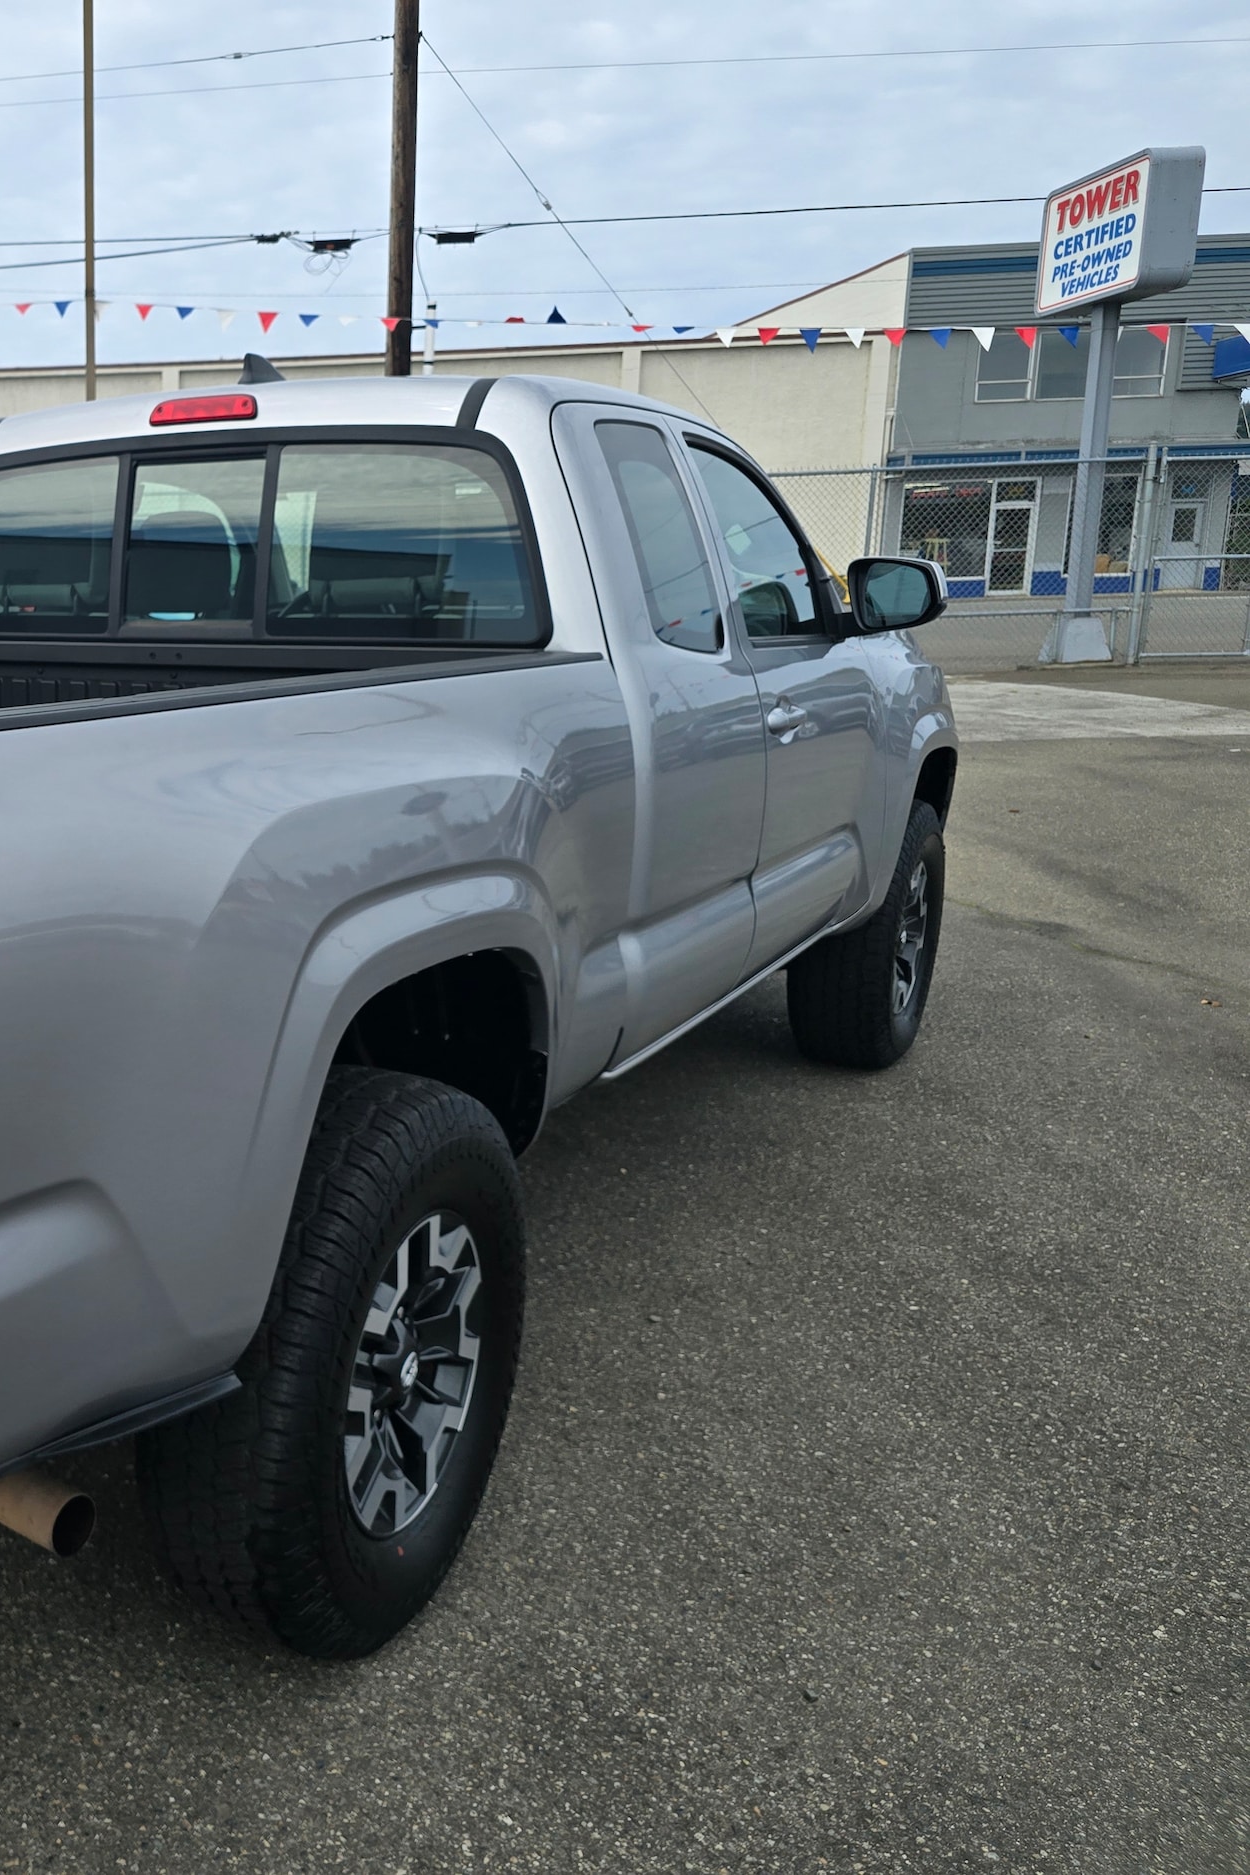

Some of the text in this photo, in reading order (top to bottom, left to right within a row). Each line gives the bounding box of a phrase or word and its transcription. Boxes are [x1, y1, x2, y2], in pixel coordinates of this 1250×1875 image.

[1057, 169, 1141, 233] TOWER
[1053, 213, 1137, 261] CERTIFIED
[1051, 239, 1134, 283] PRE-OWNED
[1061, 263, 1120, 298] VEHICLES
